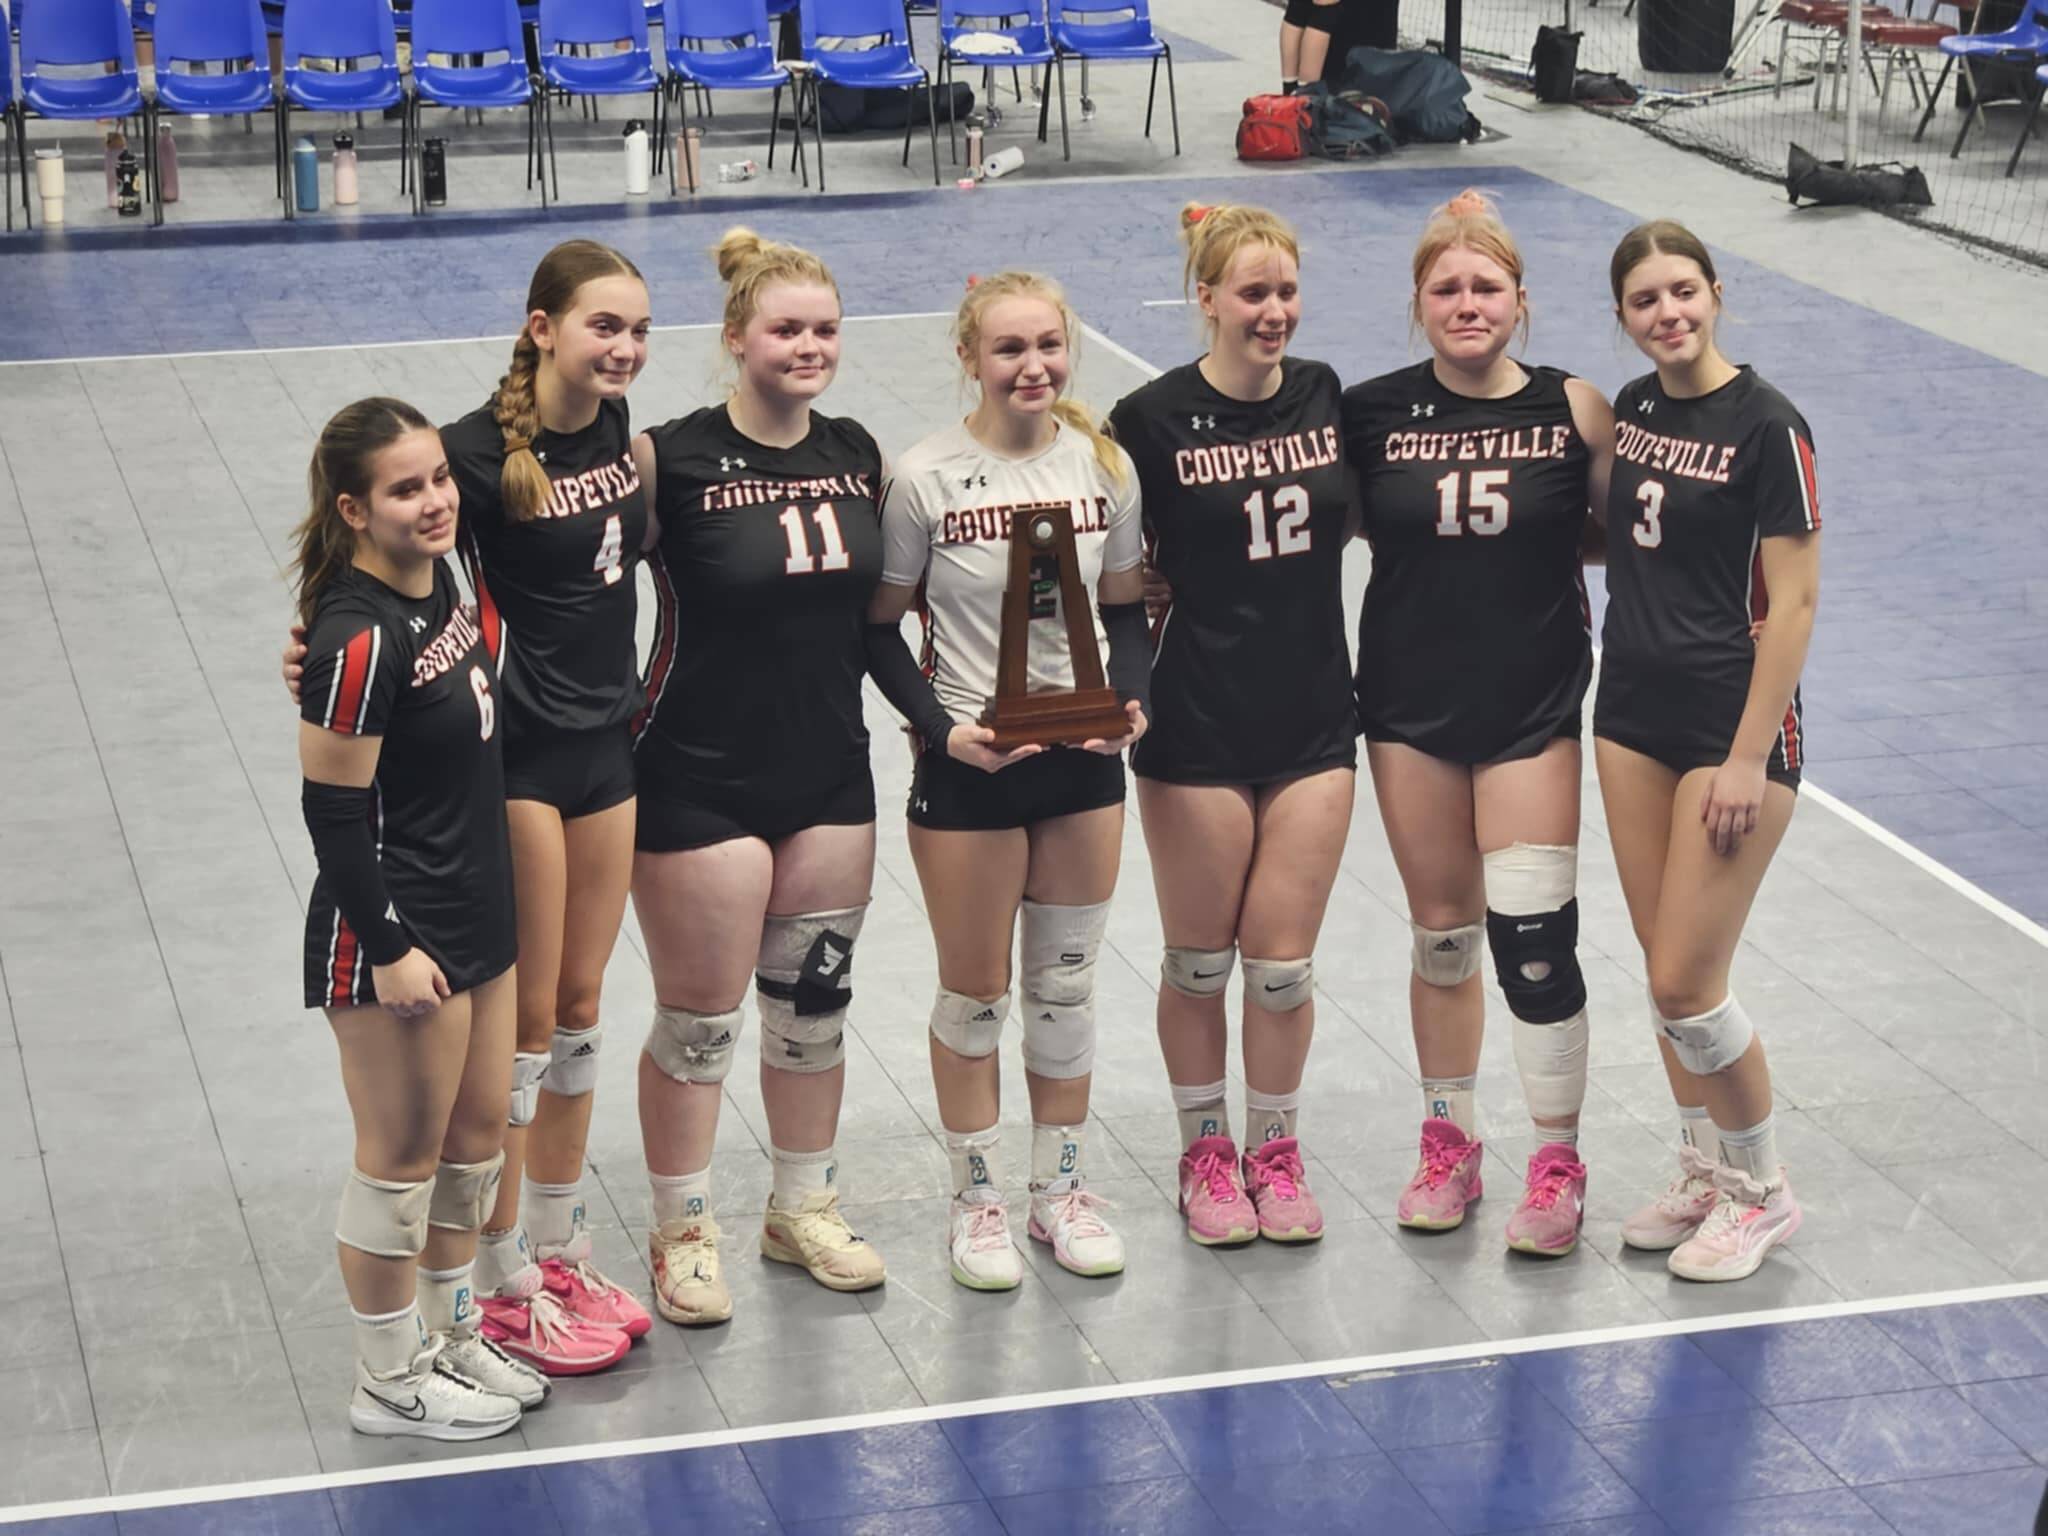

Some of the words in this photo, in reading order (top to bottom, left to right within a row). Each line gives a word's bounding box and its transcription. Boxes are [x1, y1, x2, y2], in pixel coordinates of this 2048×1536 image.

[1175, 425, 1339, 486] COUPEVILLE
[1384, 425, 1571, 462] COUPEVILLE
[777, 500, 850, 575] 11
[1242, 483, 1312, 562] 12
[1436, 468, 1510, 536] 15
[1631, 479, 1665, 549] 3
[592, 513, 624, 587] 4
[469, 663, 495, 743] 6
